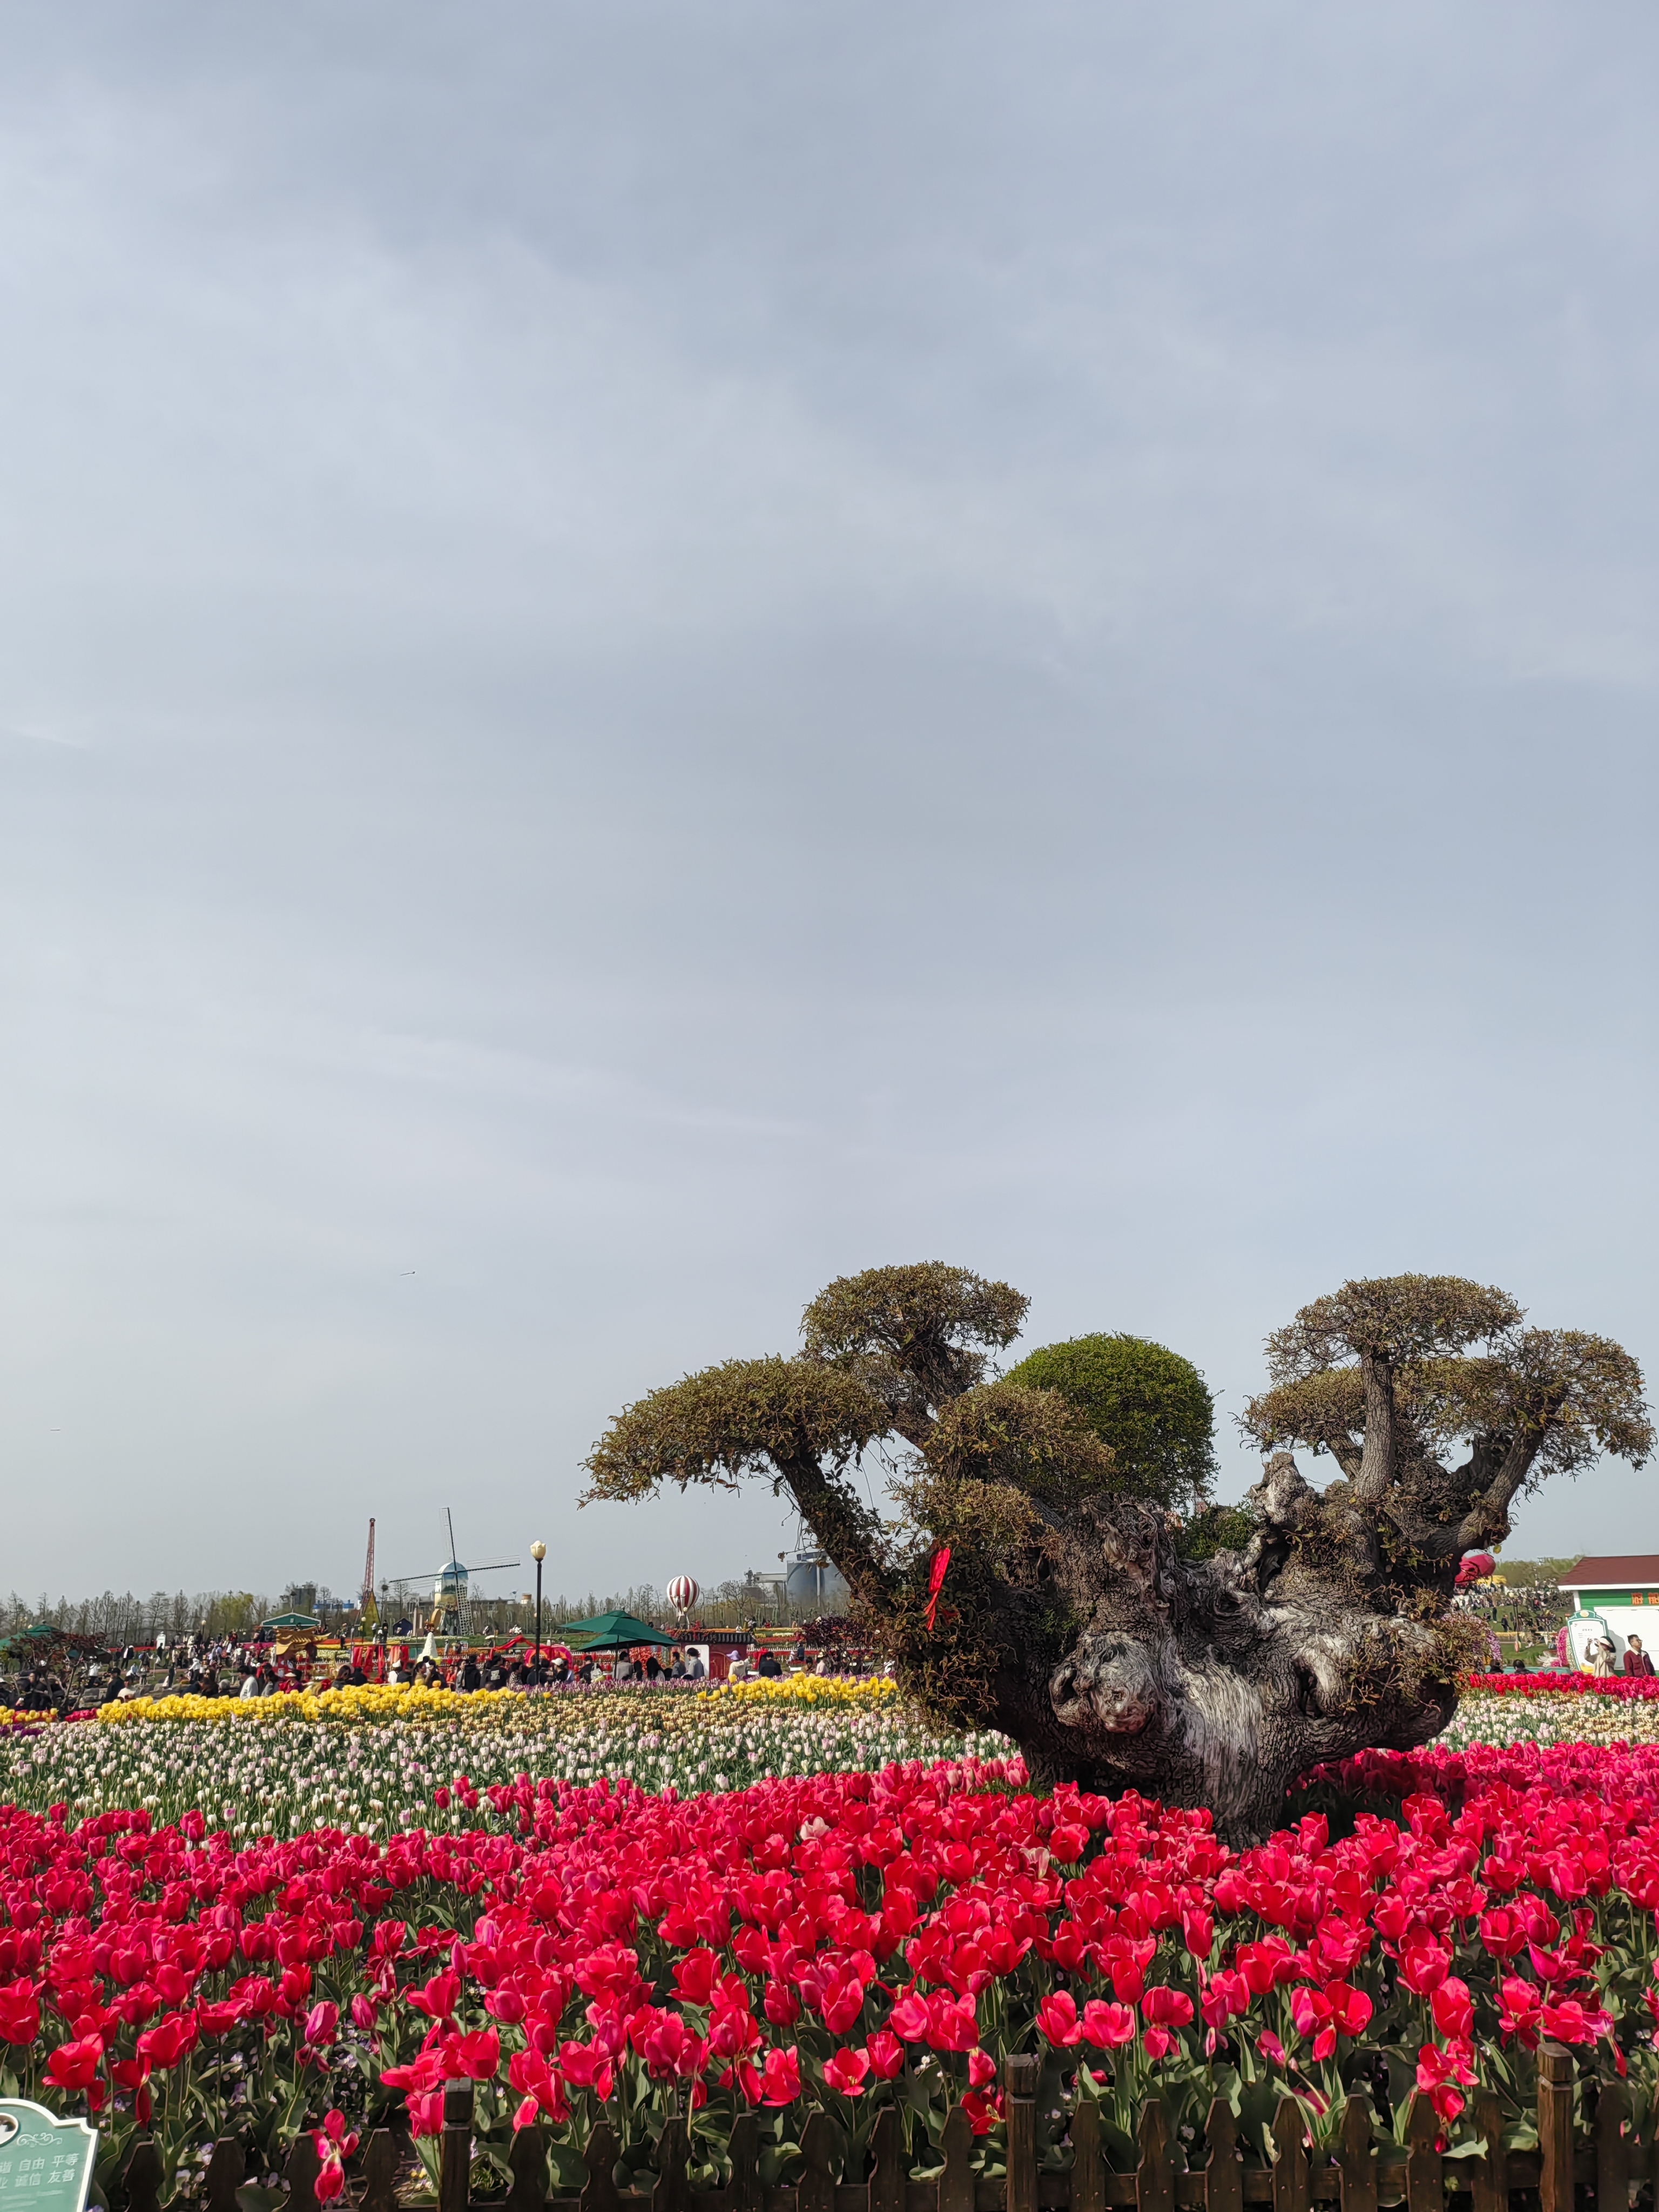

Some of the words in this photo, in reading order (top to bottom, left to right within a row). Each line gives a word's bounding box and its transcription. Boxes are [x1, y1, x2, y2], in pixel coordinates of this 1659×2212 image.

[19, 2157, 45, 2171] 自由
[51, 2153, 79, 2168] 平等
[15, 2173, 41, 2187] 诚信
[48, 2168, 75, 2183] 友善
